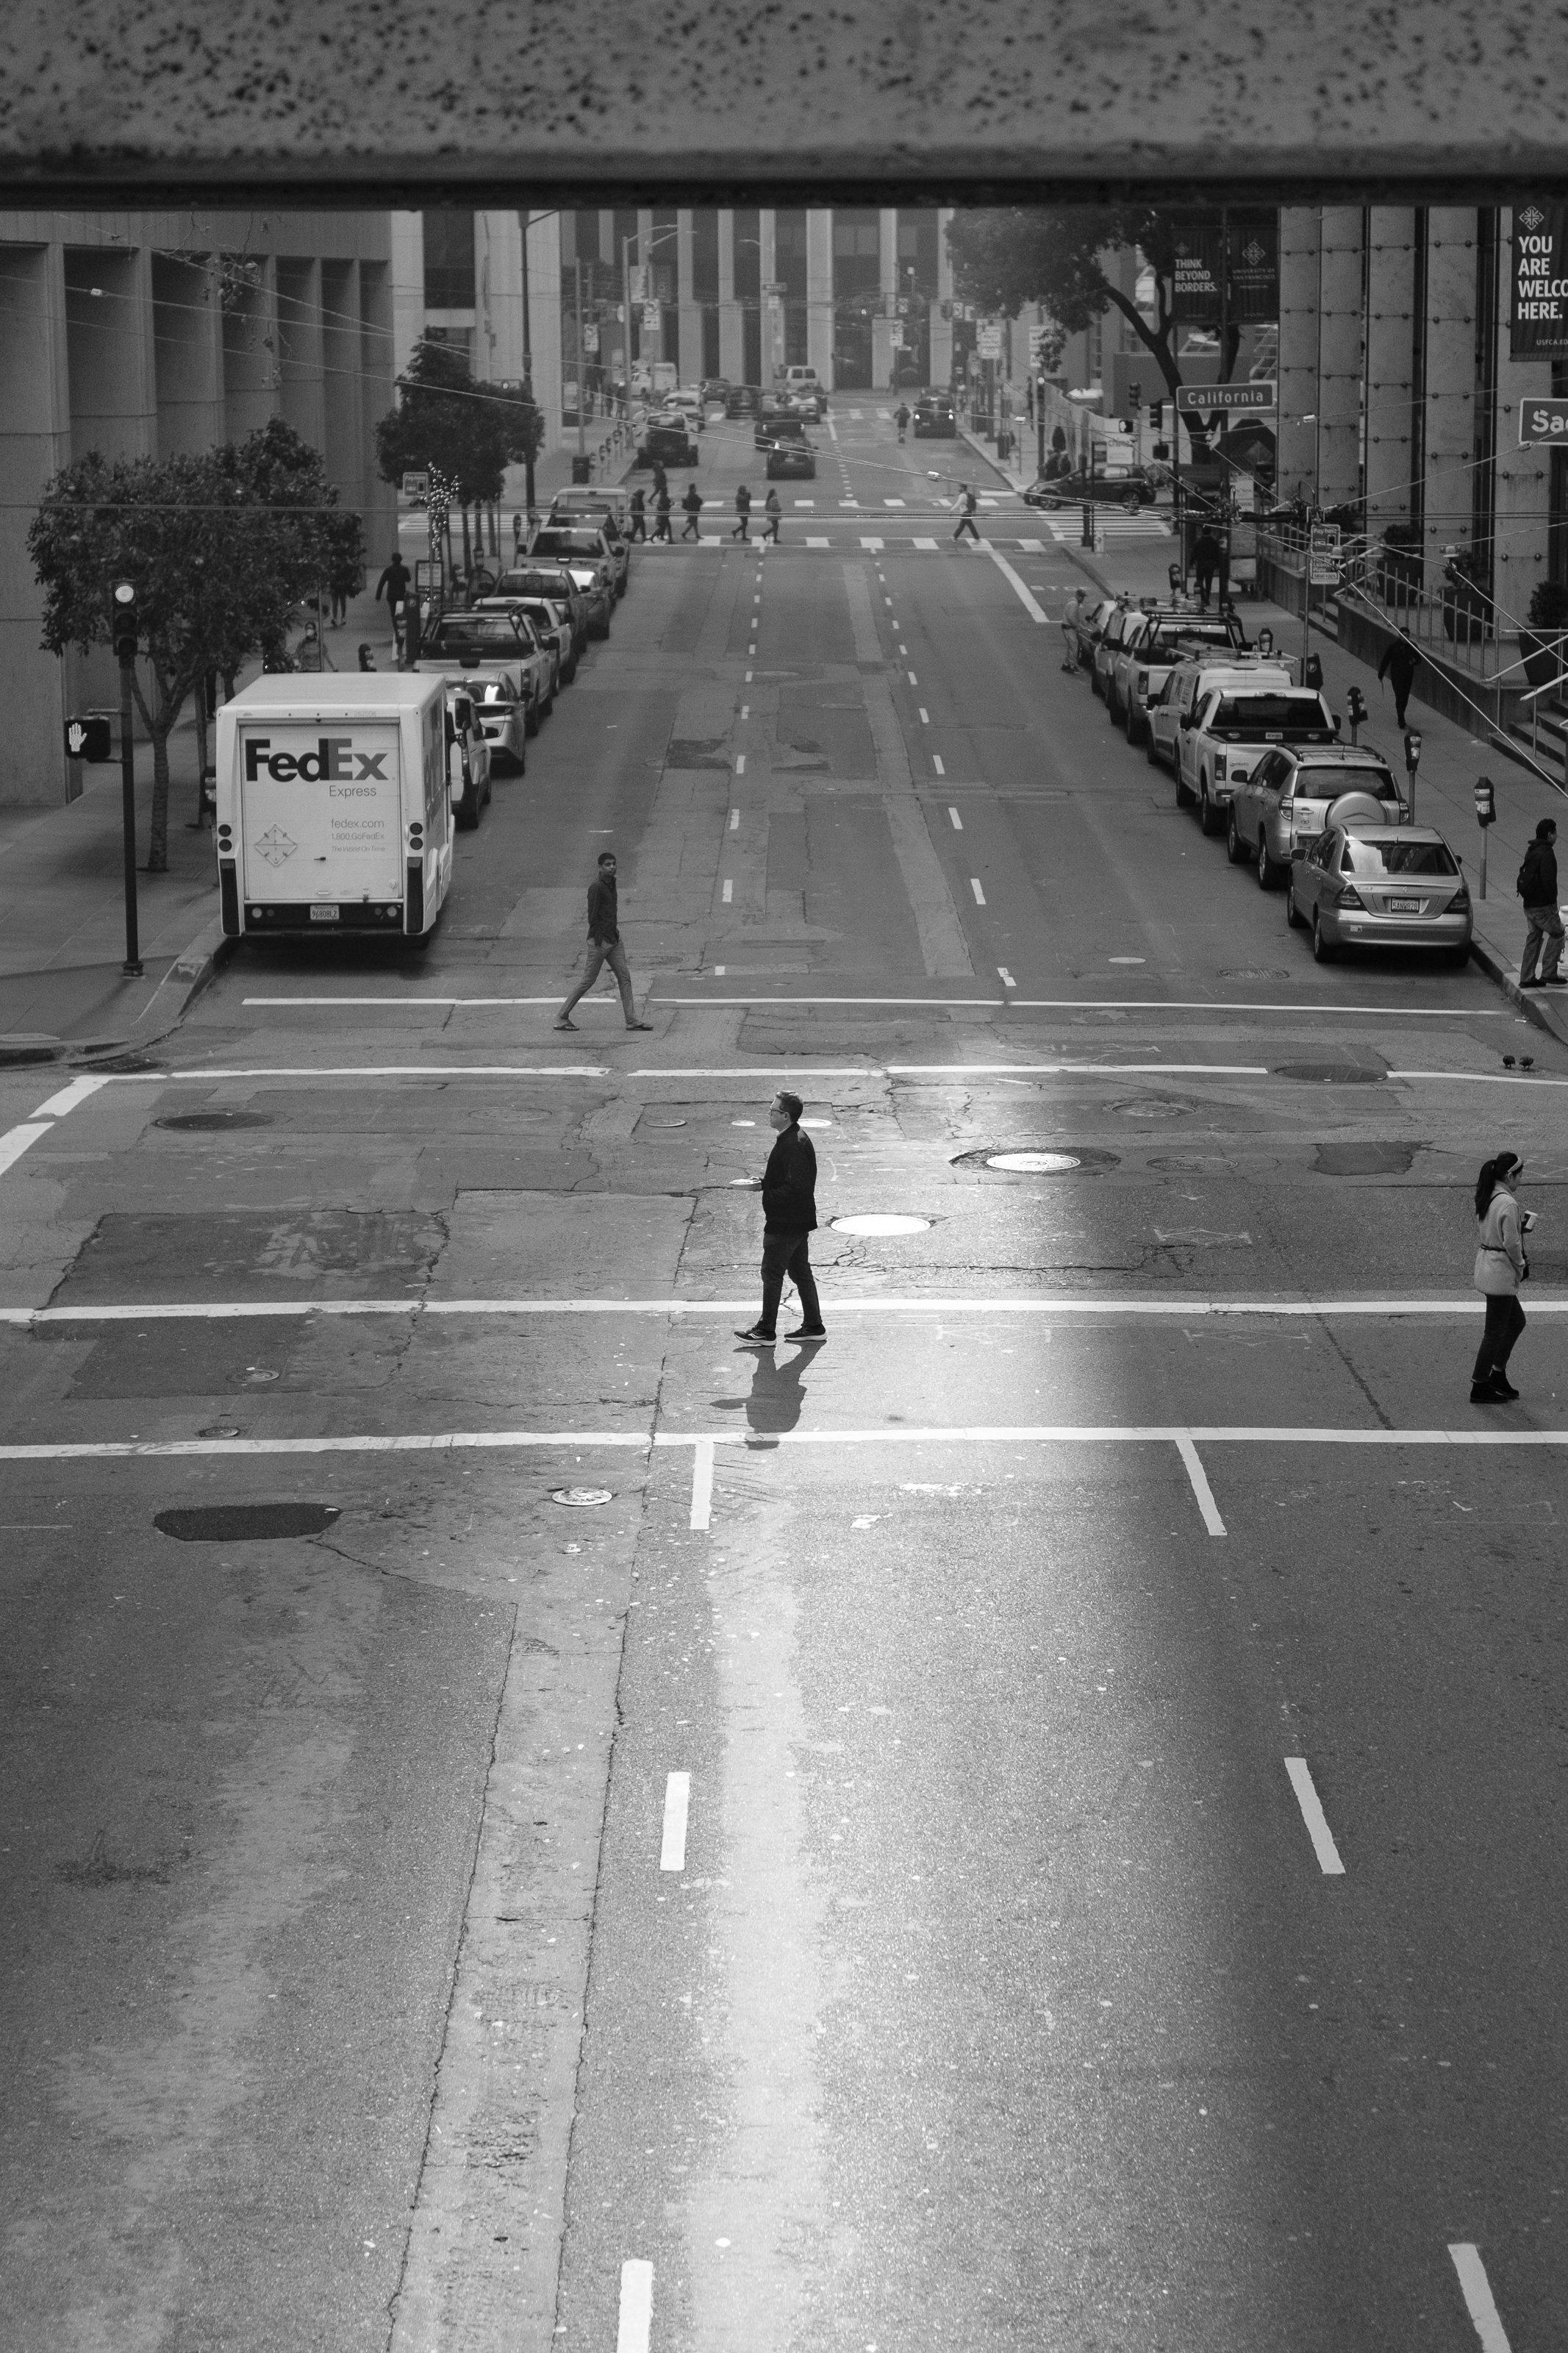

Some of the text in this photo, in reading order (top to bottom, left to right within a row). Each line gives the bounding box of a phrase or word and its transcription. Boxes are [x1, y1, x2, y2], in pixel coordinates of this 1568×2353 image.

[1518, 235, 1553, 254] YOU
[1175, 259, 1203, 268] THINK
[1518, 257, 1550, 276] ARE
[1175, 271, 1211, 281] BEYOND
[1175, 282, 1217, 292] BORDERS.
[1518, 279, 1568, 298] WELCO
[1518, 301, 1563, 320] HERE.
[1187, 390, 1264, 404] California
[1531, 410, 1568, 432] Sa
[246, 738, 389, 782] FedEx
[329, 785, 376, 799] Express
[331, 818, 384, 828] fedex.com
